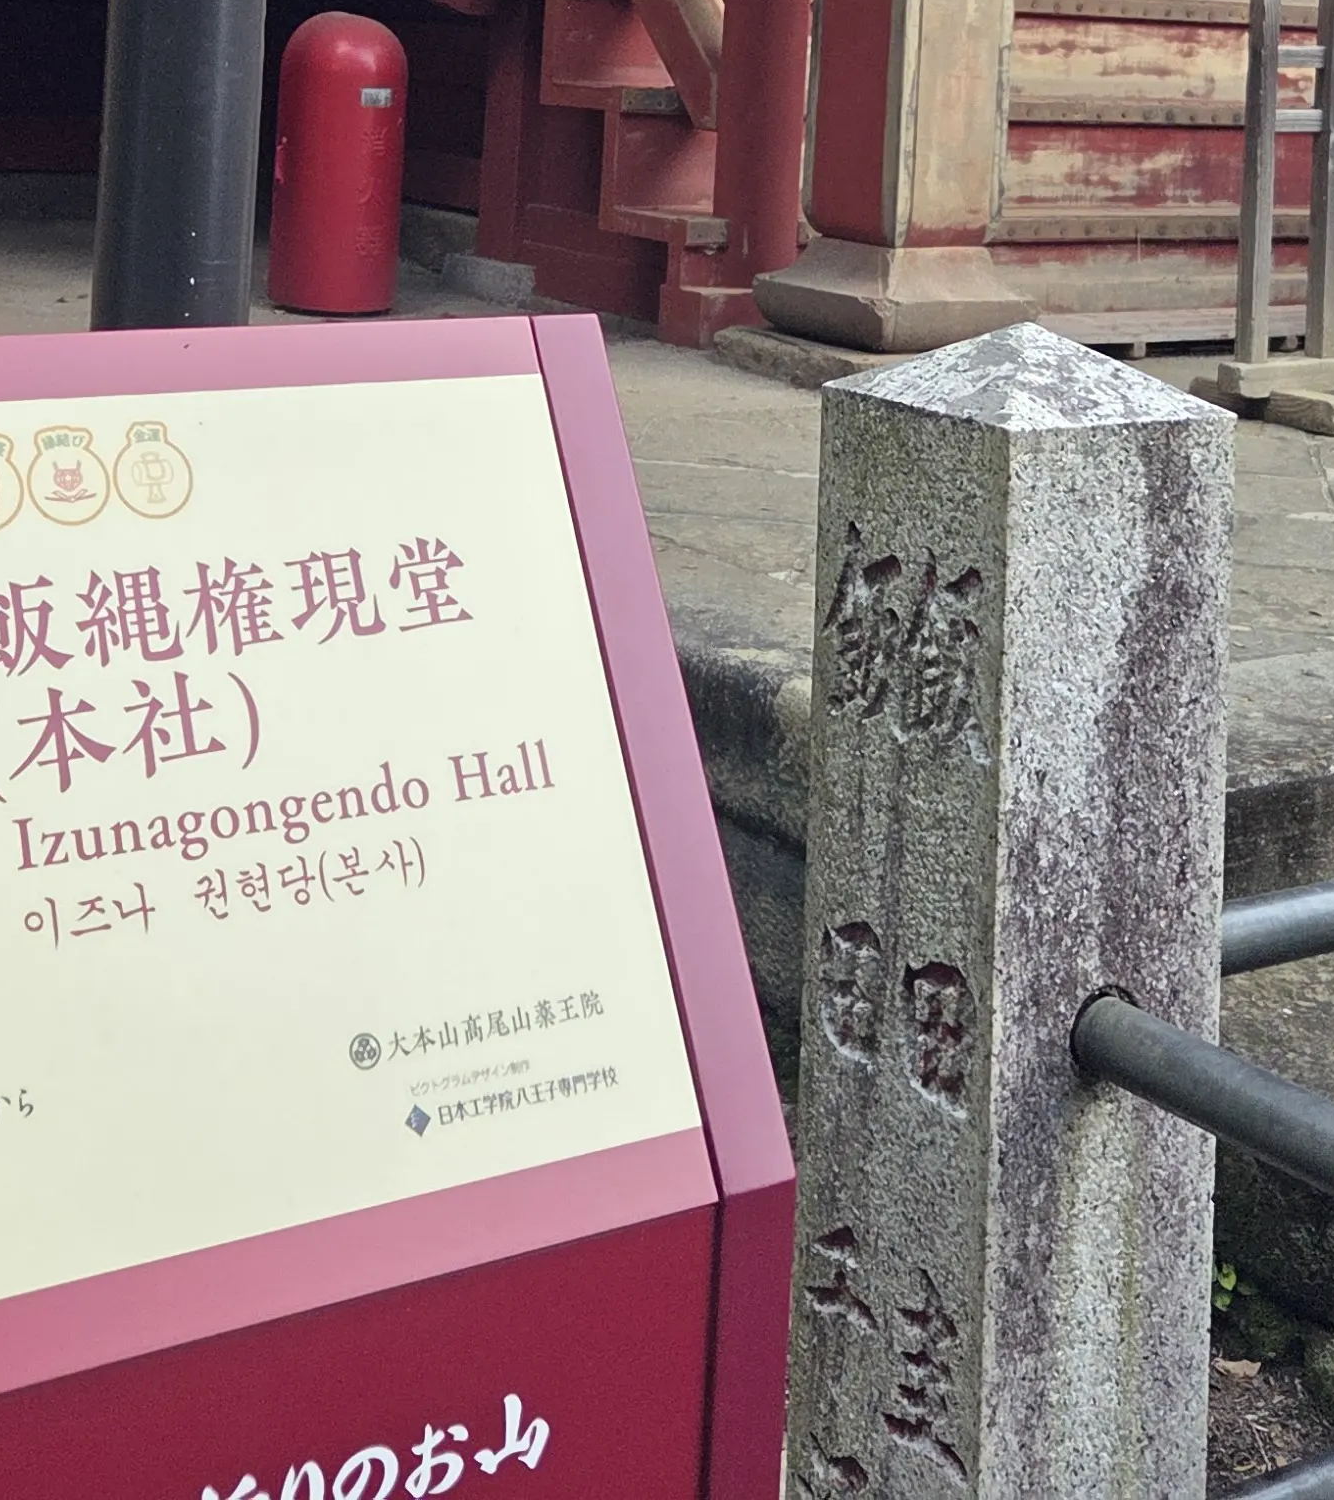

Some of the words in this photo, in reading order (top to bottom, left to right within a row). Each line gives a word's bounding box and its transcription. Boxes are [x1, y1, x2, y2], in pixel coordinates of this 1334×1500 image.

[13, 761, 430, 871] Izunagongendo
[448, 739, 556, 803] Hall
[23, 882, 156, 950] 이즈나
[193, 836, 426, 921] 권현당(본사)
